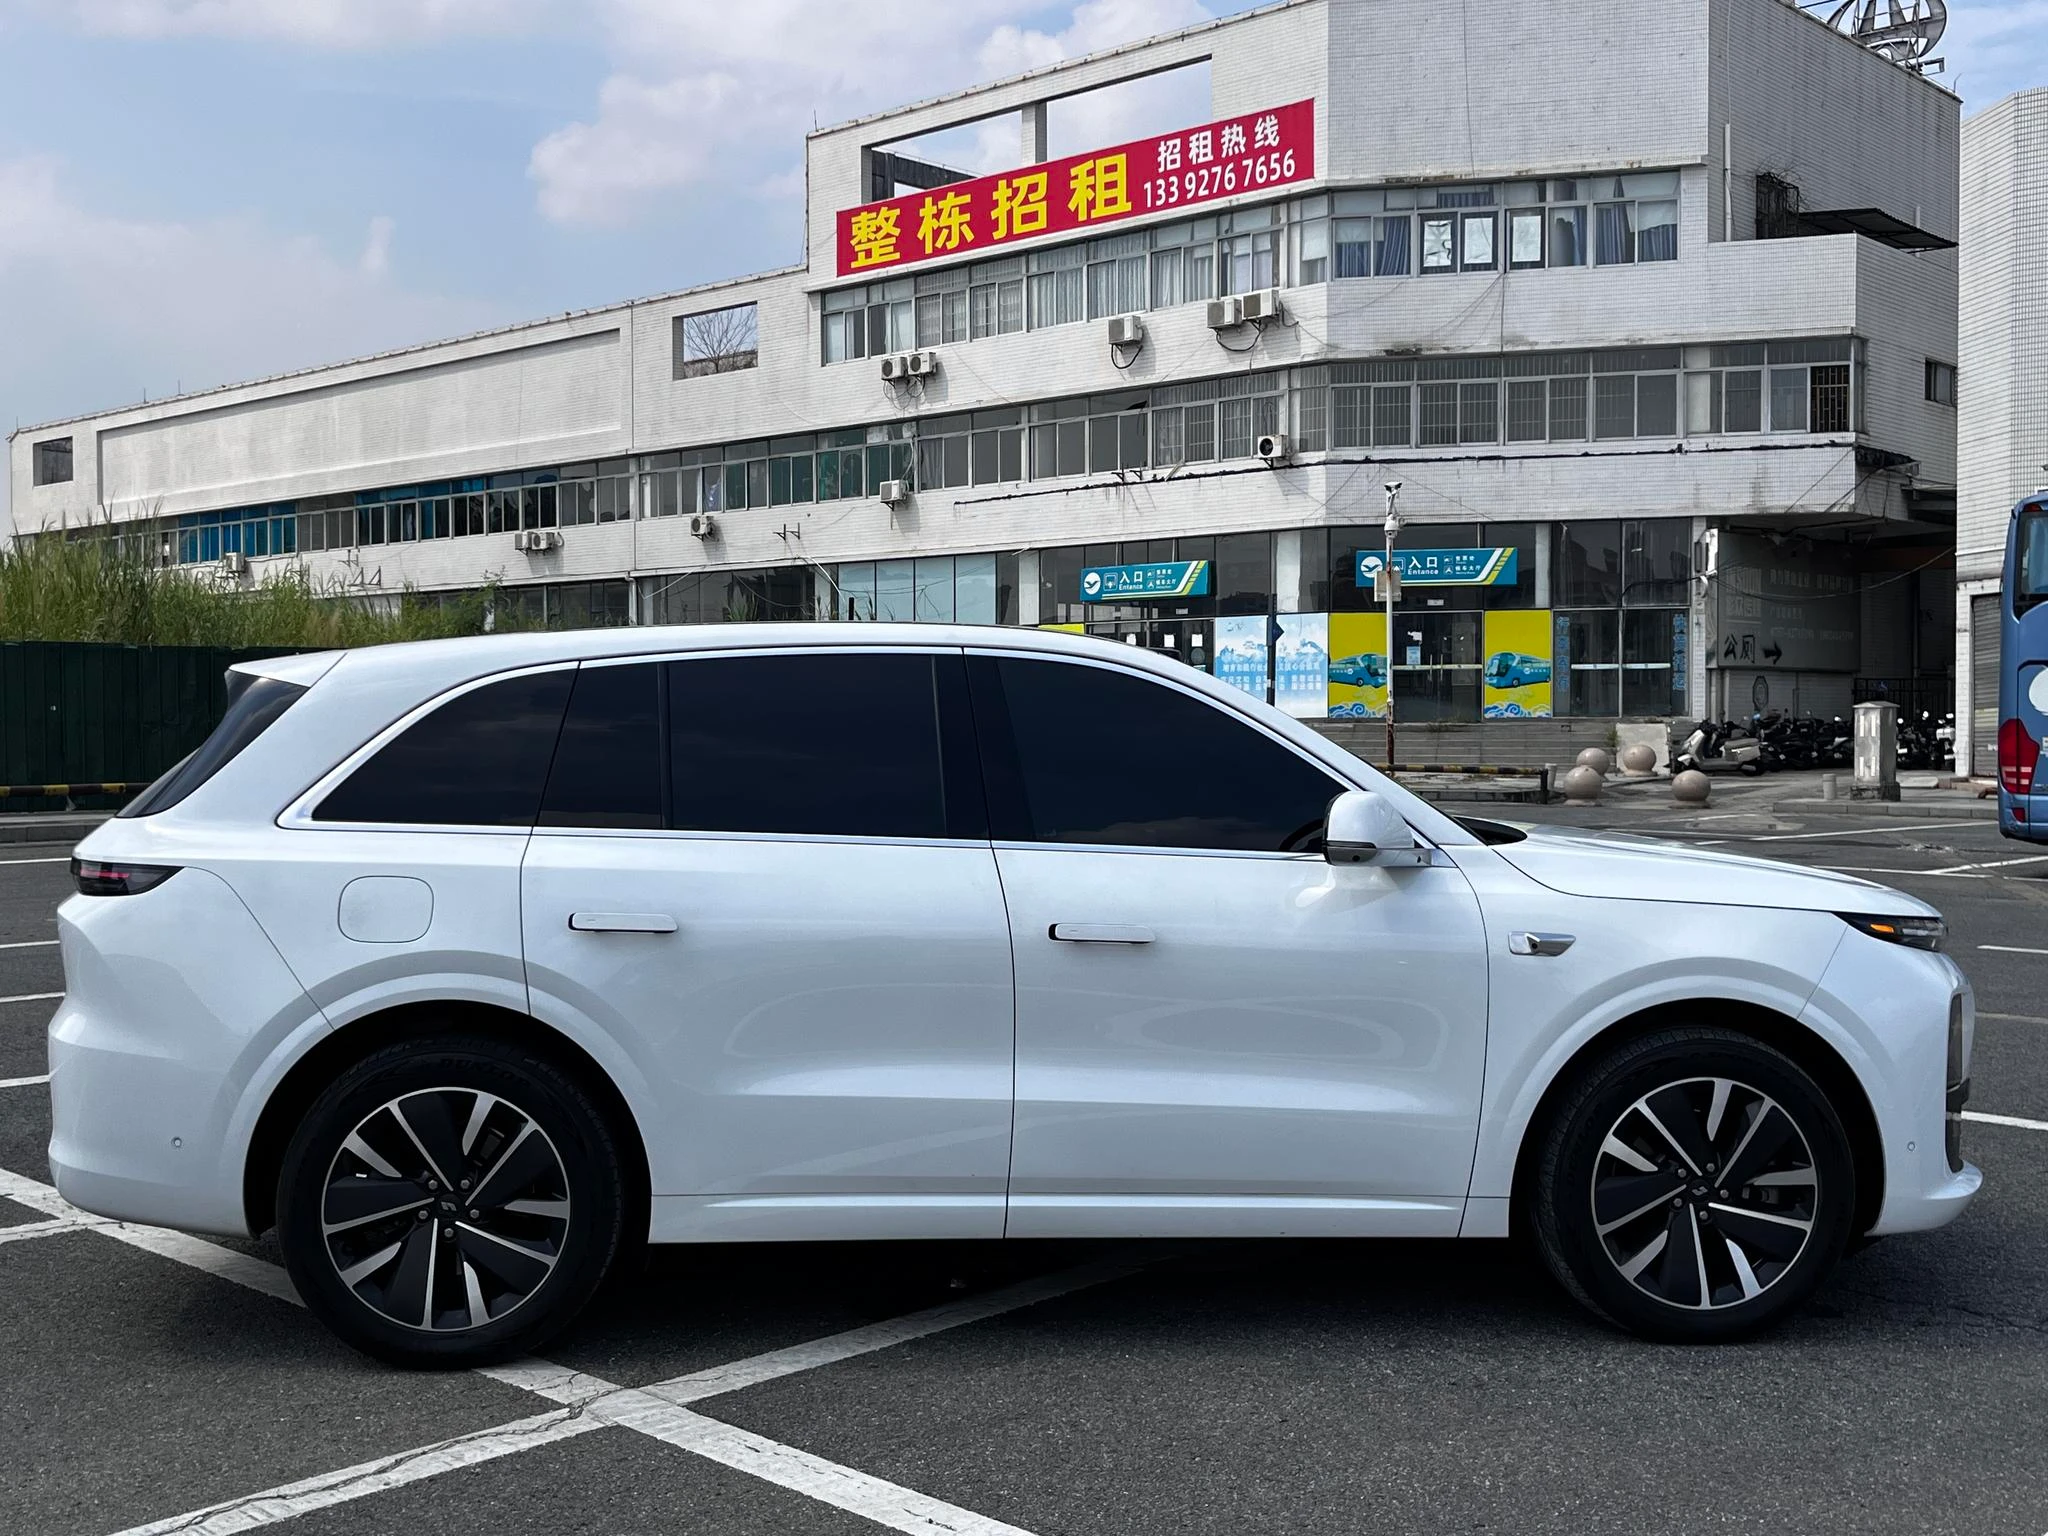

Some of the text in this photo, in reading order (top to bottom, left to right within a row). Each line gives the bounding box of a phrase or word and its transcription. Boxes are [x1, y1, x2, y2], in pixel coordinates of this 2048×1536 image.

[1157, 114, 1280, 174] 招租热线
[1143, 148, 1296, 208] 133 9276 7656
[849, 152, 1132, 269] 整栋招租
[1120, 570, 1143, 584] 入口
[1408, 555, 1438, 569] 入口
[1724, 633, 1756, 664] 公厕
